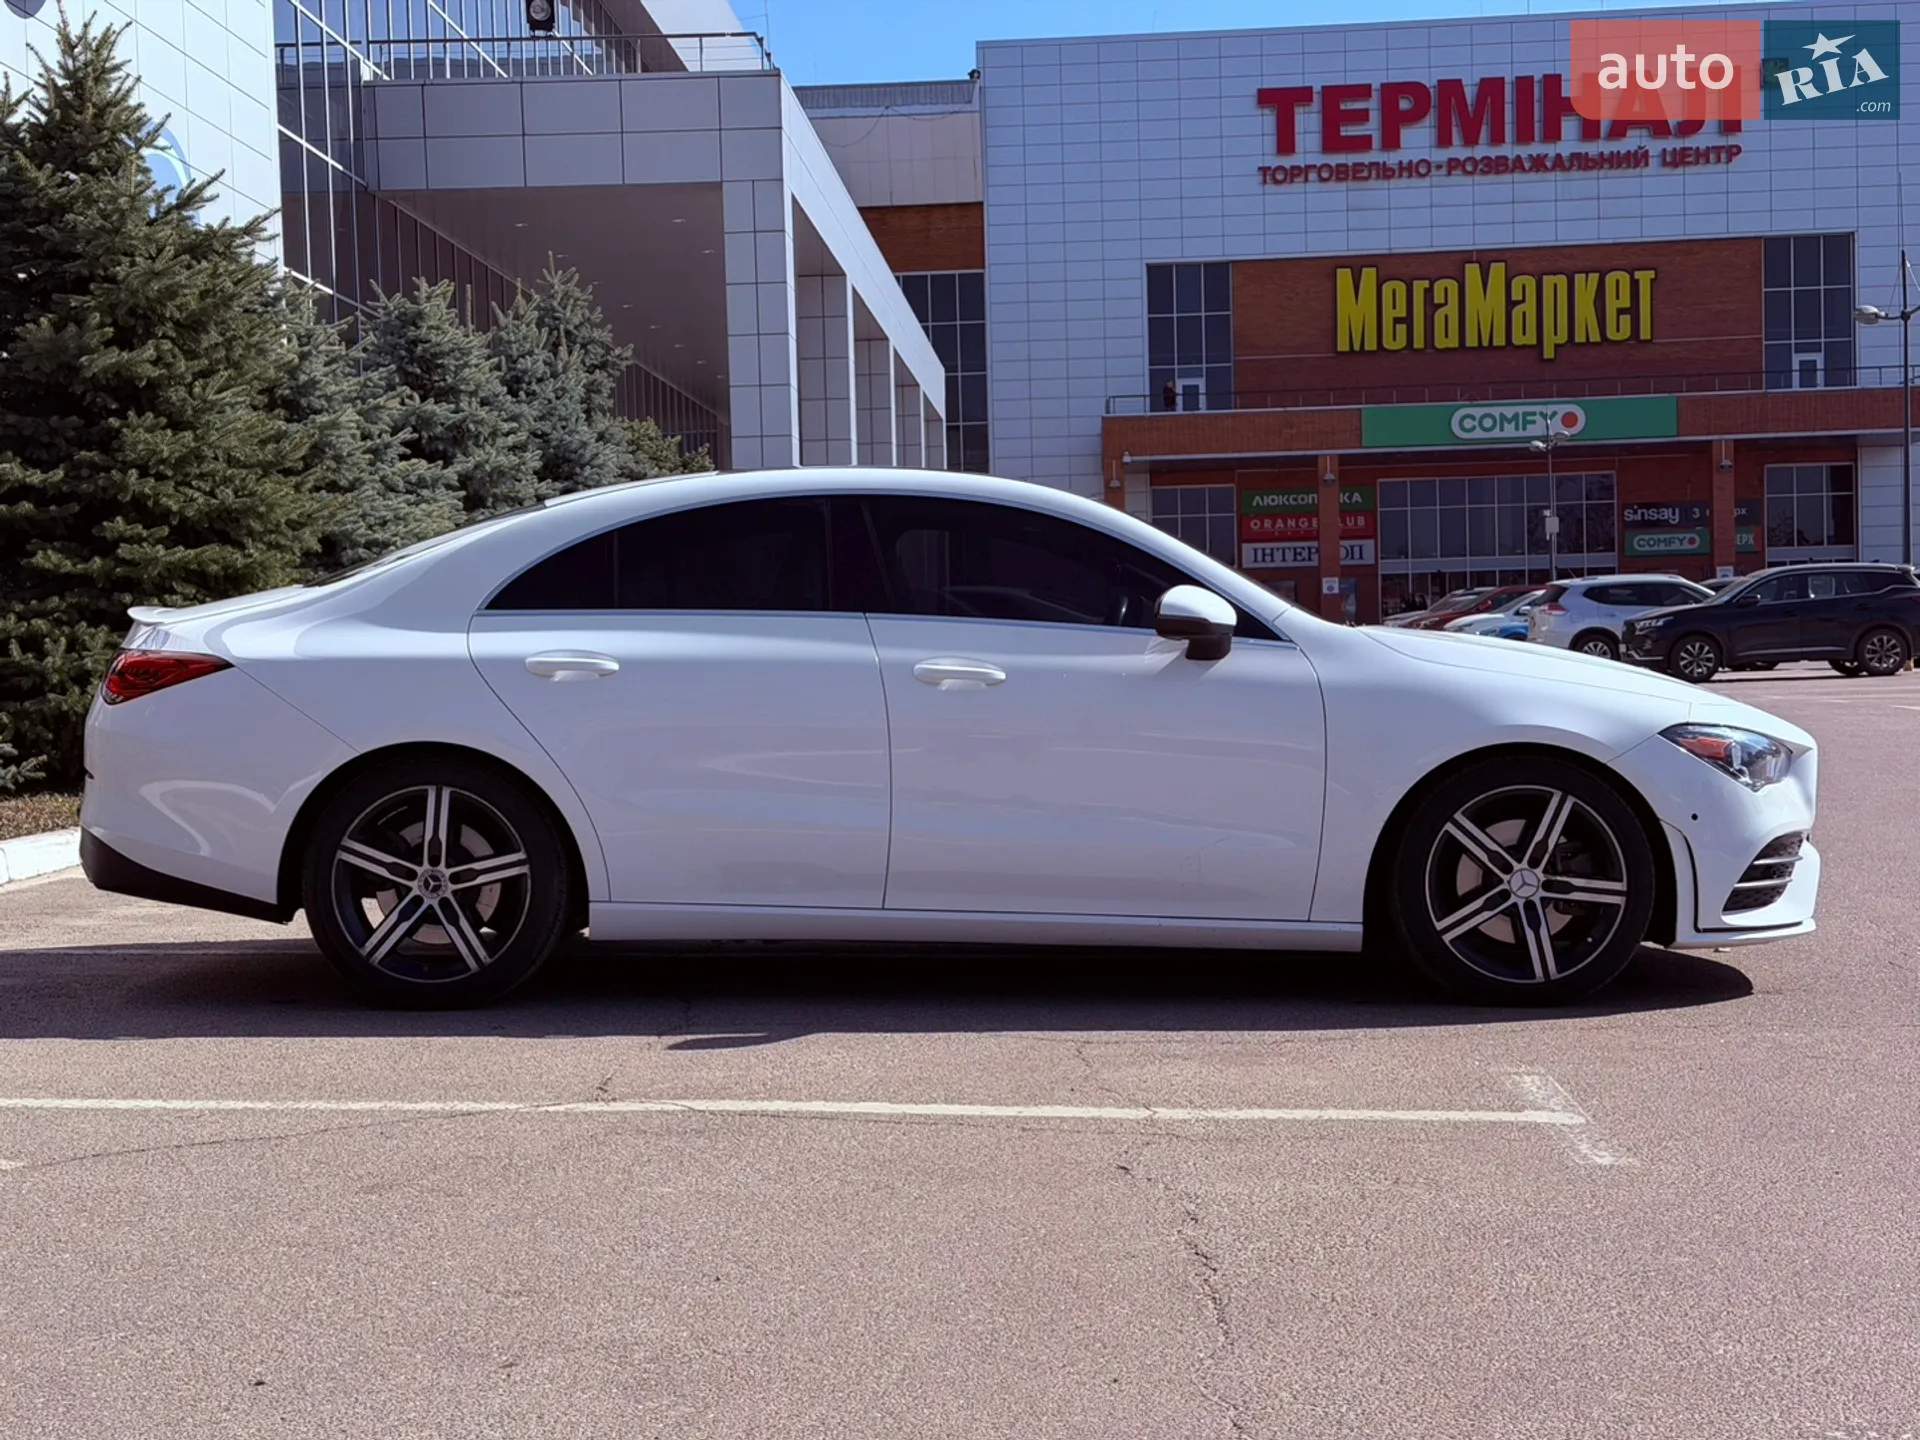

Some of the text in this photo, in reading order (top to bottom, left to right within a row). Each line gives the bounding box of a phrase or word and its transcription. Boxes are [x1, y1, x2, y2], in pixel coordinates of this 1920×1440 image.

[1257, 65, 1743, 155] ТЕРМІНАЛ
[1258, 144, 1743, 185] ТОРГОВЕЛЬНО-РОЗВАЖАЛЬНИЙ ЦЕНТР
[1335, 261, 1657, 360] МегаМаркет
[1458, 410, 1558, 434] COMFY
[1252, 492, 1363, 507] ЛЮКСОПКА
[1250, 517, 1319, 530] ORANGE
[1623, 504, 1680, 525] sinsay
[1637, 536, 1686, 548] COMFY
[1252, 544, 1365, 563] ІНТЕРОП
